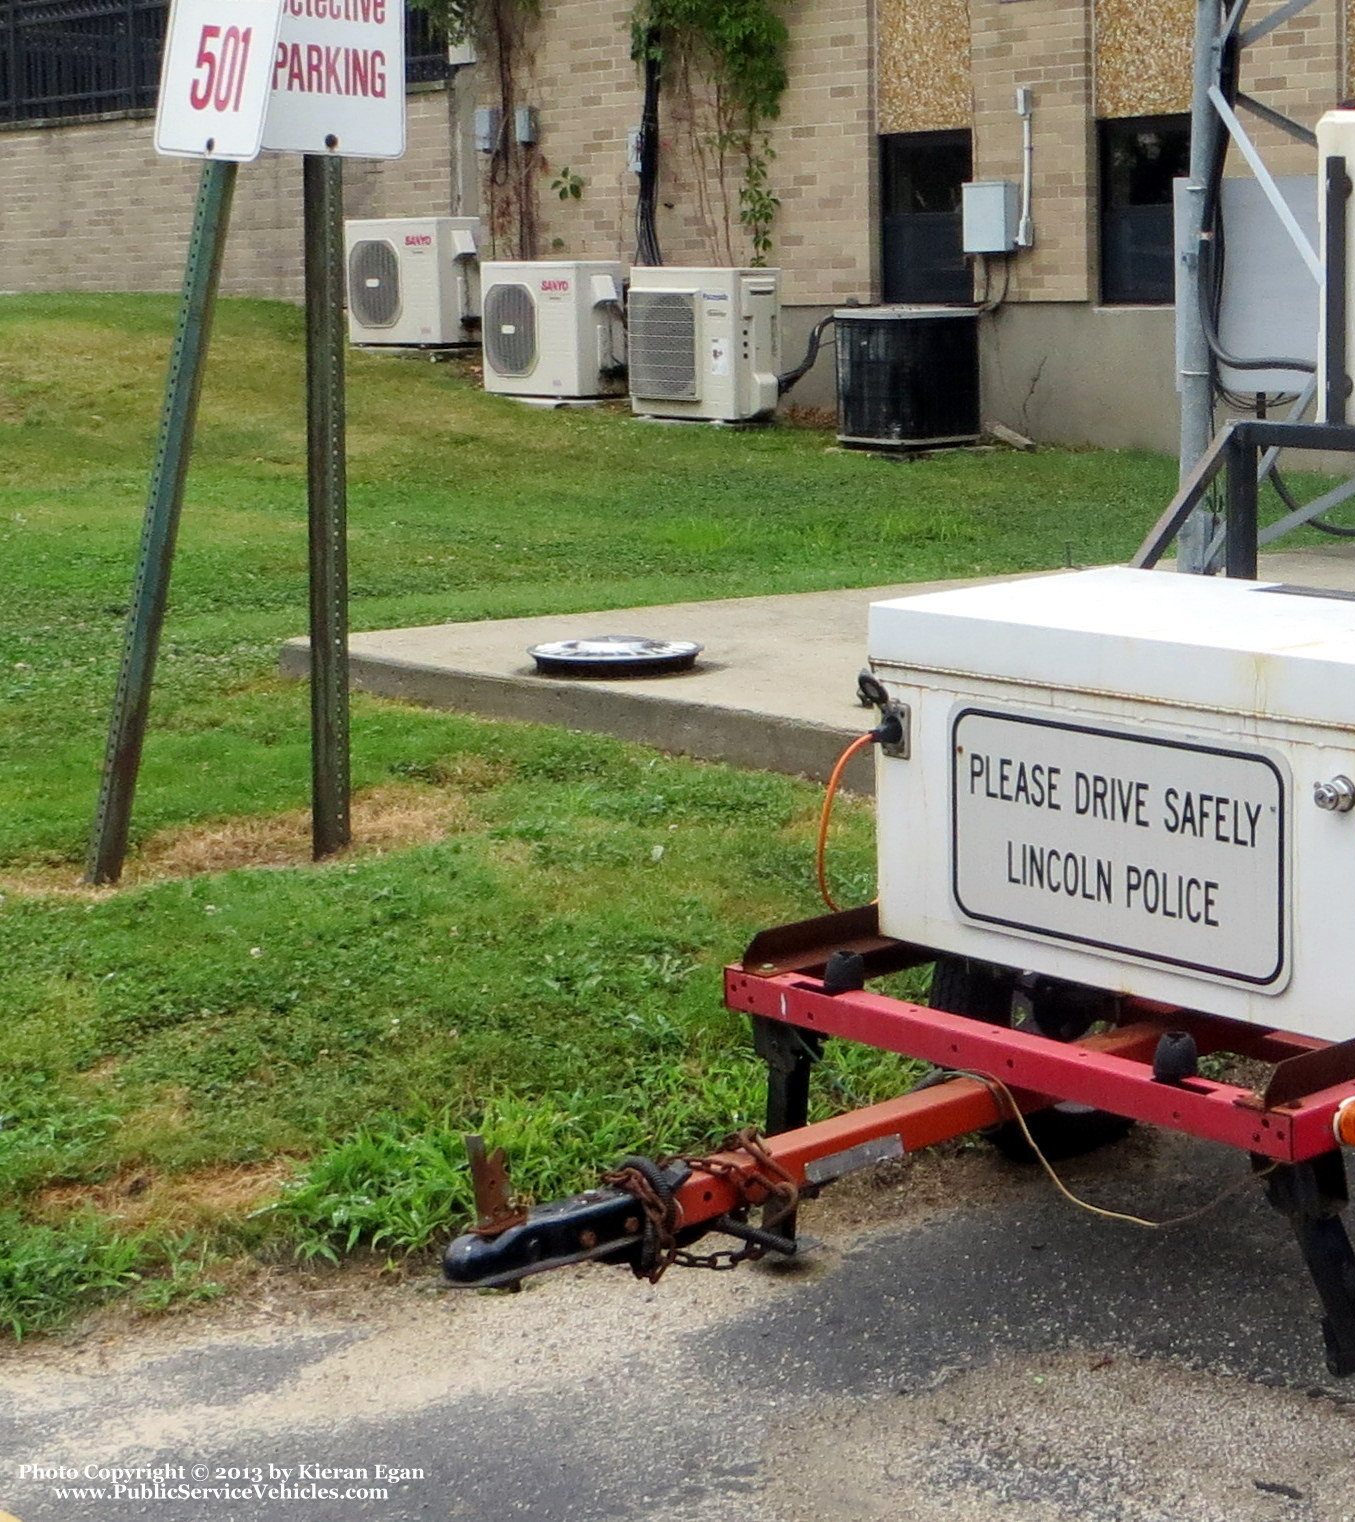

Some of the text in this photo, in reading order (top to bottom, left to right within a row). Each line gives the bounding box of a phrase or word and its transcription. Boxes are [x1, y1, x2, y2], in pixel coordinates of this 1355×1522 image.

[190, 25, 252, 112] 501
[272, 42, 386, 98] PARKING
[541, 281, 569, 291] SANYO
[970, 753, 1262, 848] PLEASE DRIVE SAFELY
[1007, 840, 1219, 927] LINCOLN POLICE
